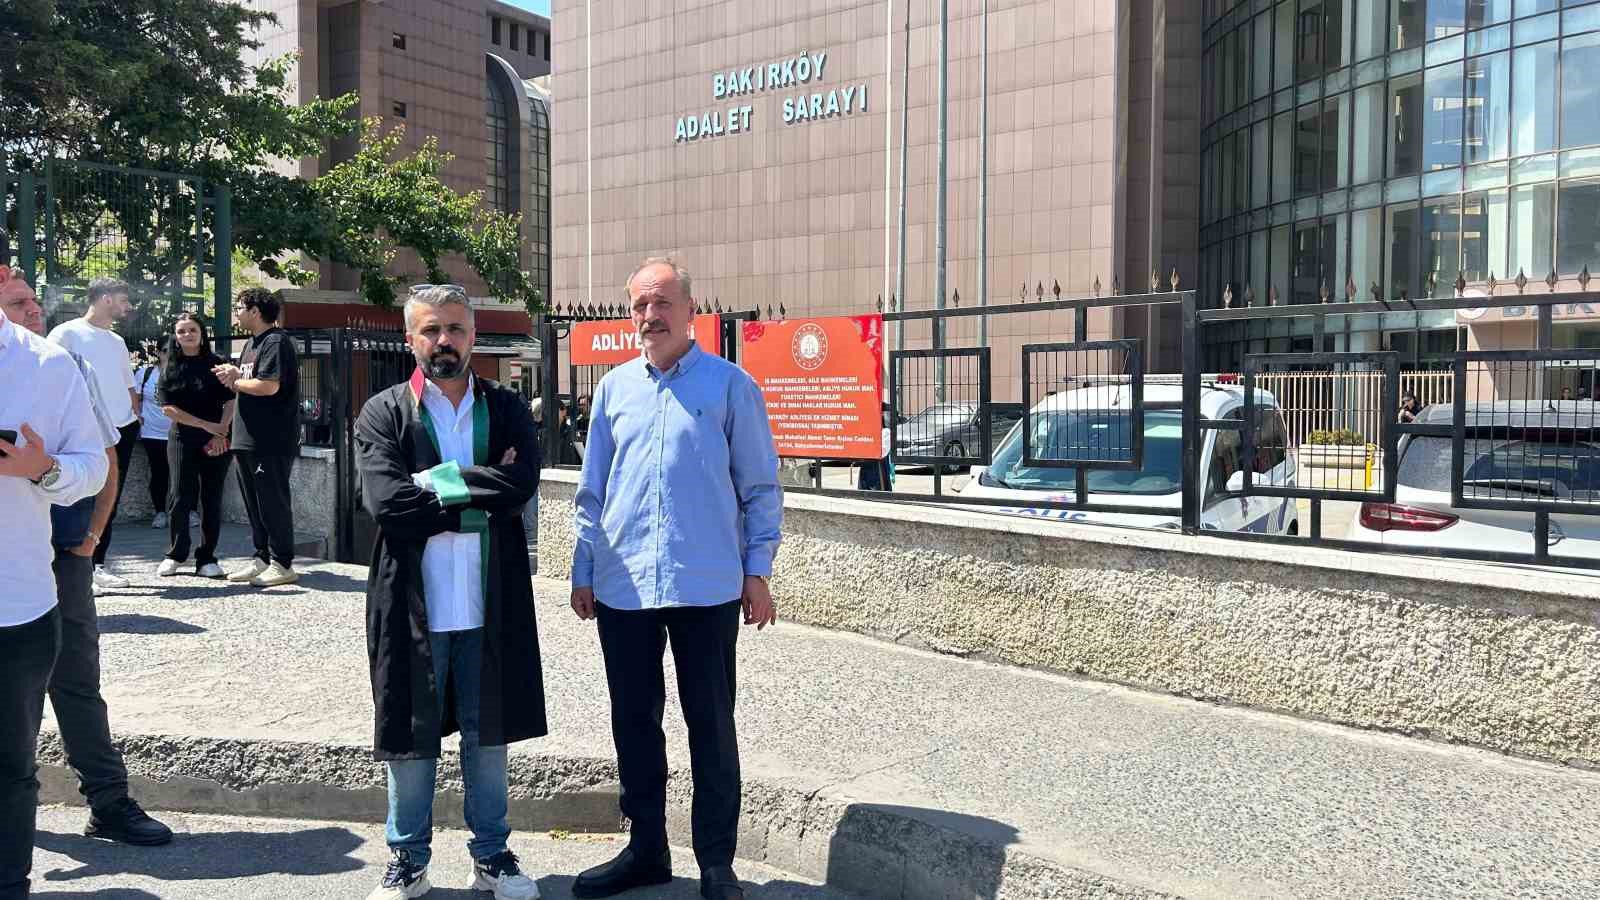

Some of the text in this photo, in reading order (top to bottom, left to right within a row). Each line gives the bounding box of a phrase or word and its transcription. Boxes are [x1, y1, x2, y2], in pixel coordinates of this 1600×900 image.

[713, 50, 826, 98] BAKIRKÖY
[674, 84, 867, 142] ADALET SARAYI
